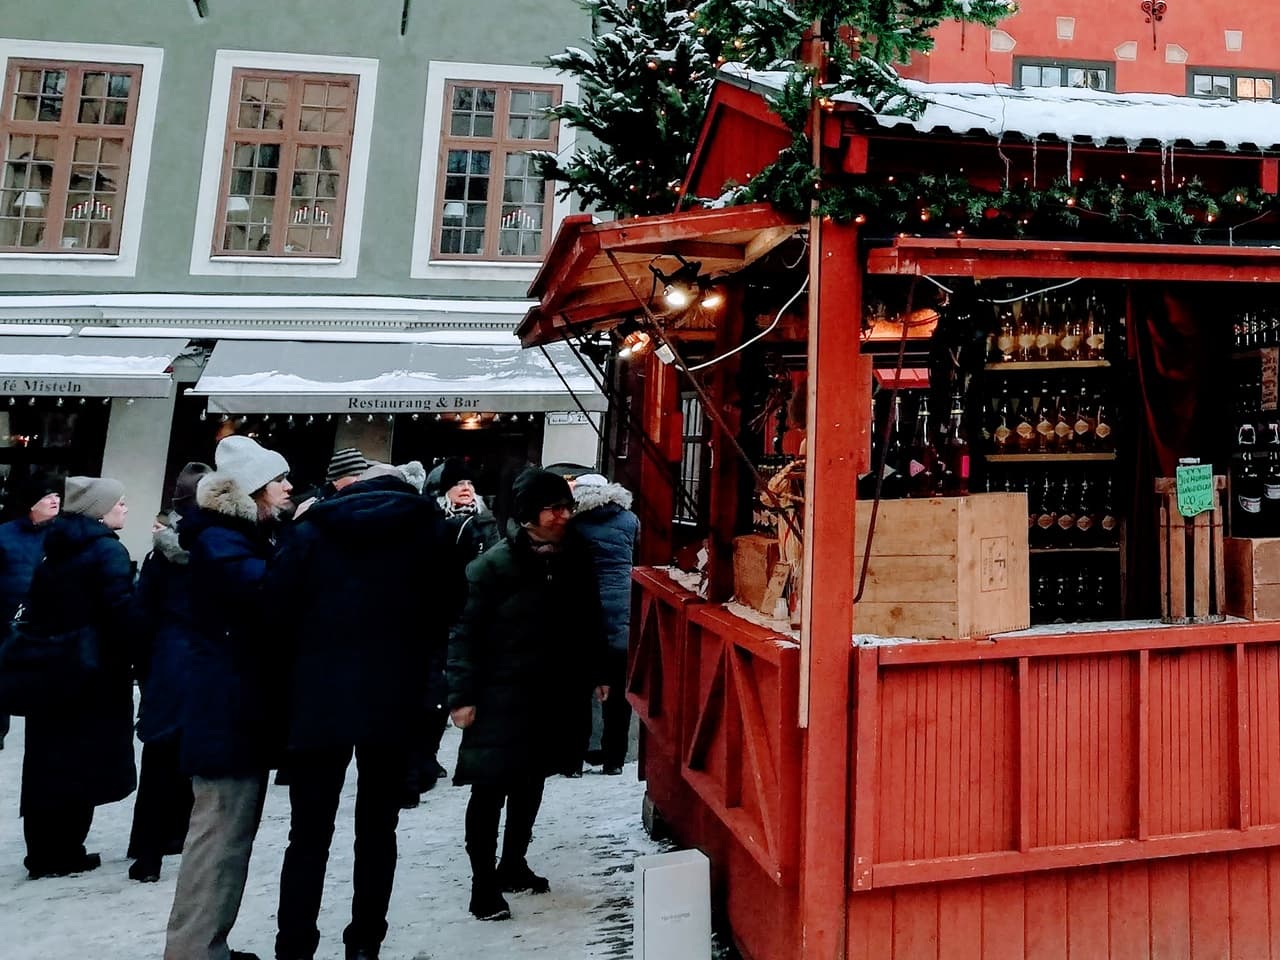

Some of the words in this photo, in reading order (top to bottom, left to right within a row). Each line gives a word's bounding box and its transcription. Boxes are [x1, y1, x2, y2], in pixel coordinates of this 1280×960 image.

[0, 379, 17, 392] fé
[24, 380, 81, 392] Misteln
[348, 397, 431, 410] Restaurang
[436, 396, 448, 409] &
[454, 396, 480, 408] Bar
